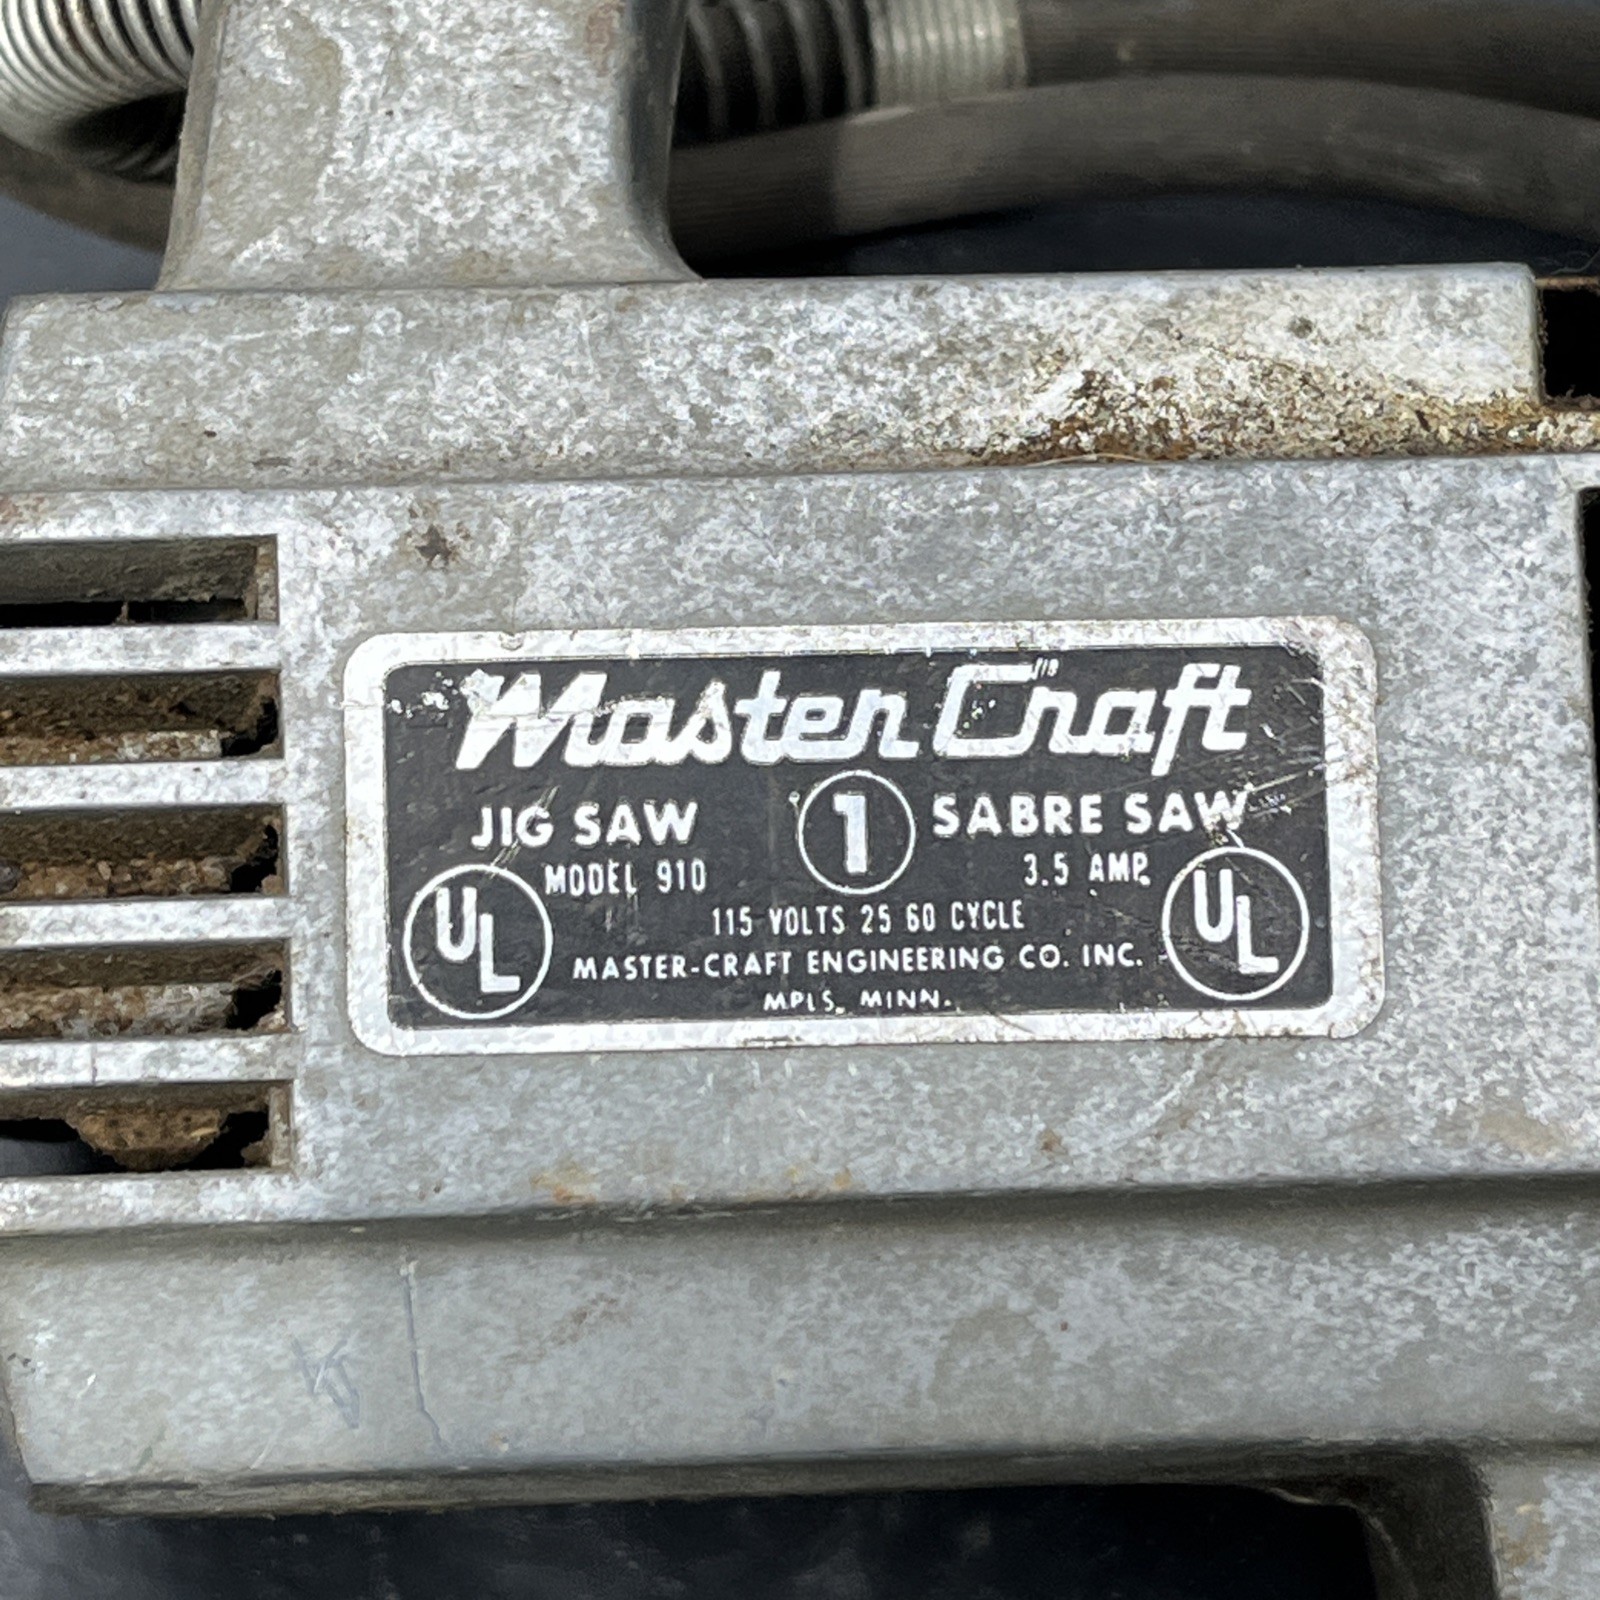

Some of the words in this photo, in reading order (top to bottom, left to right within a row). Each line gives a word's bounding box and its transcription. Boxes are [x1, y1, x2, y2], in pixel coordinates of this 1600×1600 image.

[932, 662, 1252, 776] Craft
[470, 804, 554, 849] JIG
[574, 800, 698, 846] SAW
[832, 792, 868, 874] 1
[933, 792, 1102, 837] SABRE
[1124, 790, 1249, 837] SAW
[545, 860, 638, 897] MODEL
[656, 858, 706, 893] 910
[1023, 852, 1069, 887] 3.5
[434, 886, 521, 993] UL
[712, 906, 752, 937] 115
[768, 904, 846, 936] VOLTS
[861, 903, 892, 935] 25
[906, 902, 936, 932] 60
[950, 899, 1025, 931] CYCLE
[1193, 868, 1280, 974] UL
[573, 950, 792, 980] MASTER-CRAFT
[806, 945, 1005, 976] ENGINEERING
[1018, 943, 1070, 969] CO.
[1083, 942, 1144, 968] INC.
[860, 988, 952, 1012] MINN.
